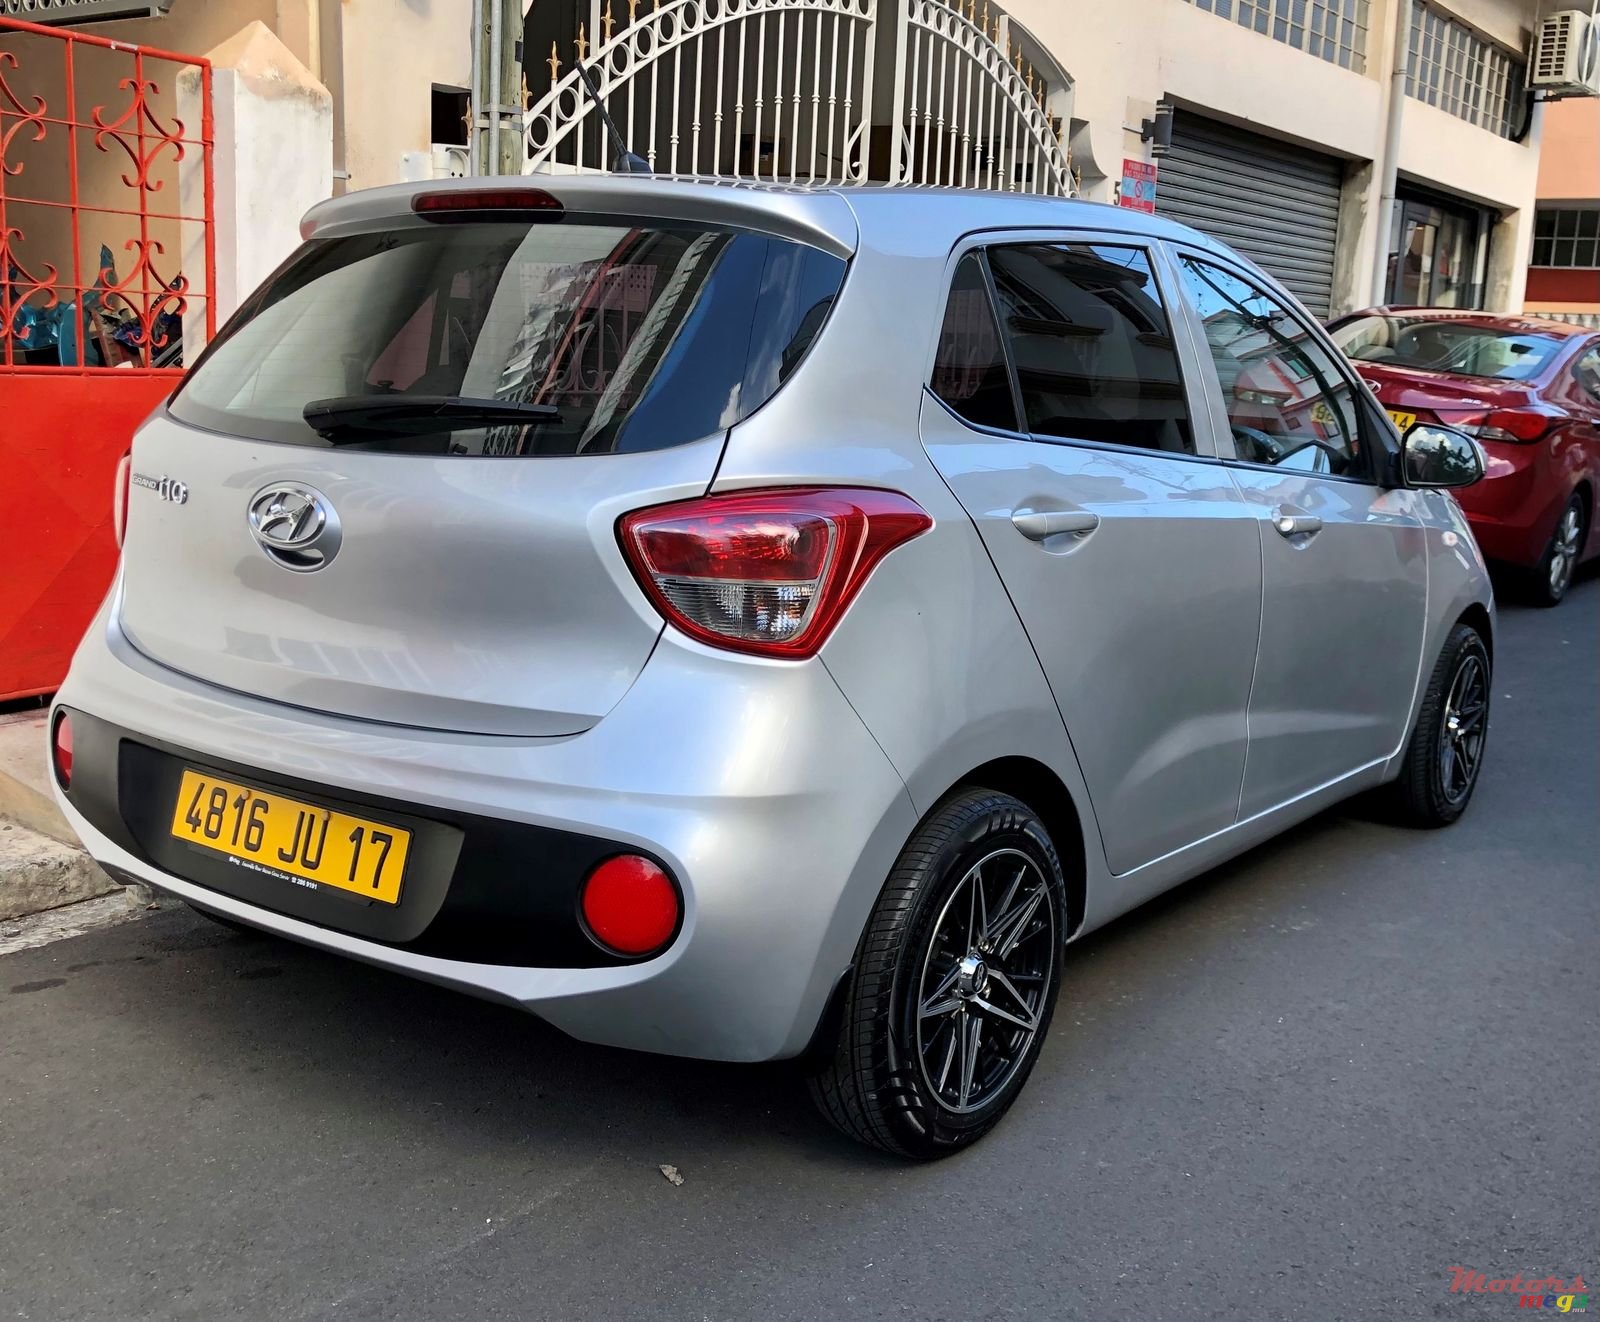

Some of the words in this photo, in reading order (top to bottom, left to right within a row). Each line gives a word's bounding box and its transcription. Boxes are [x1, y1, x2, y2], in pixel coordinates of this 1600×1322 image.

[185, 782, 269, 853] 4816
[277, 810, 330, 871] JU
[348, 825, 394, 890] 17
